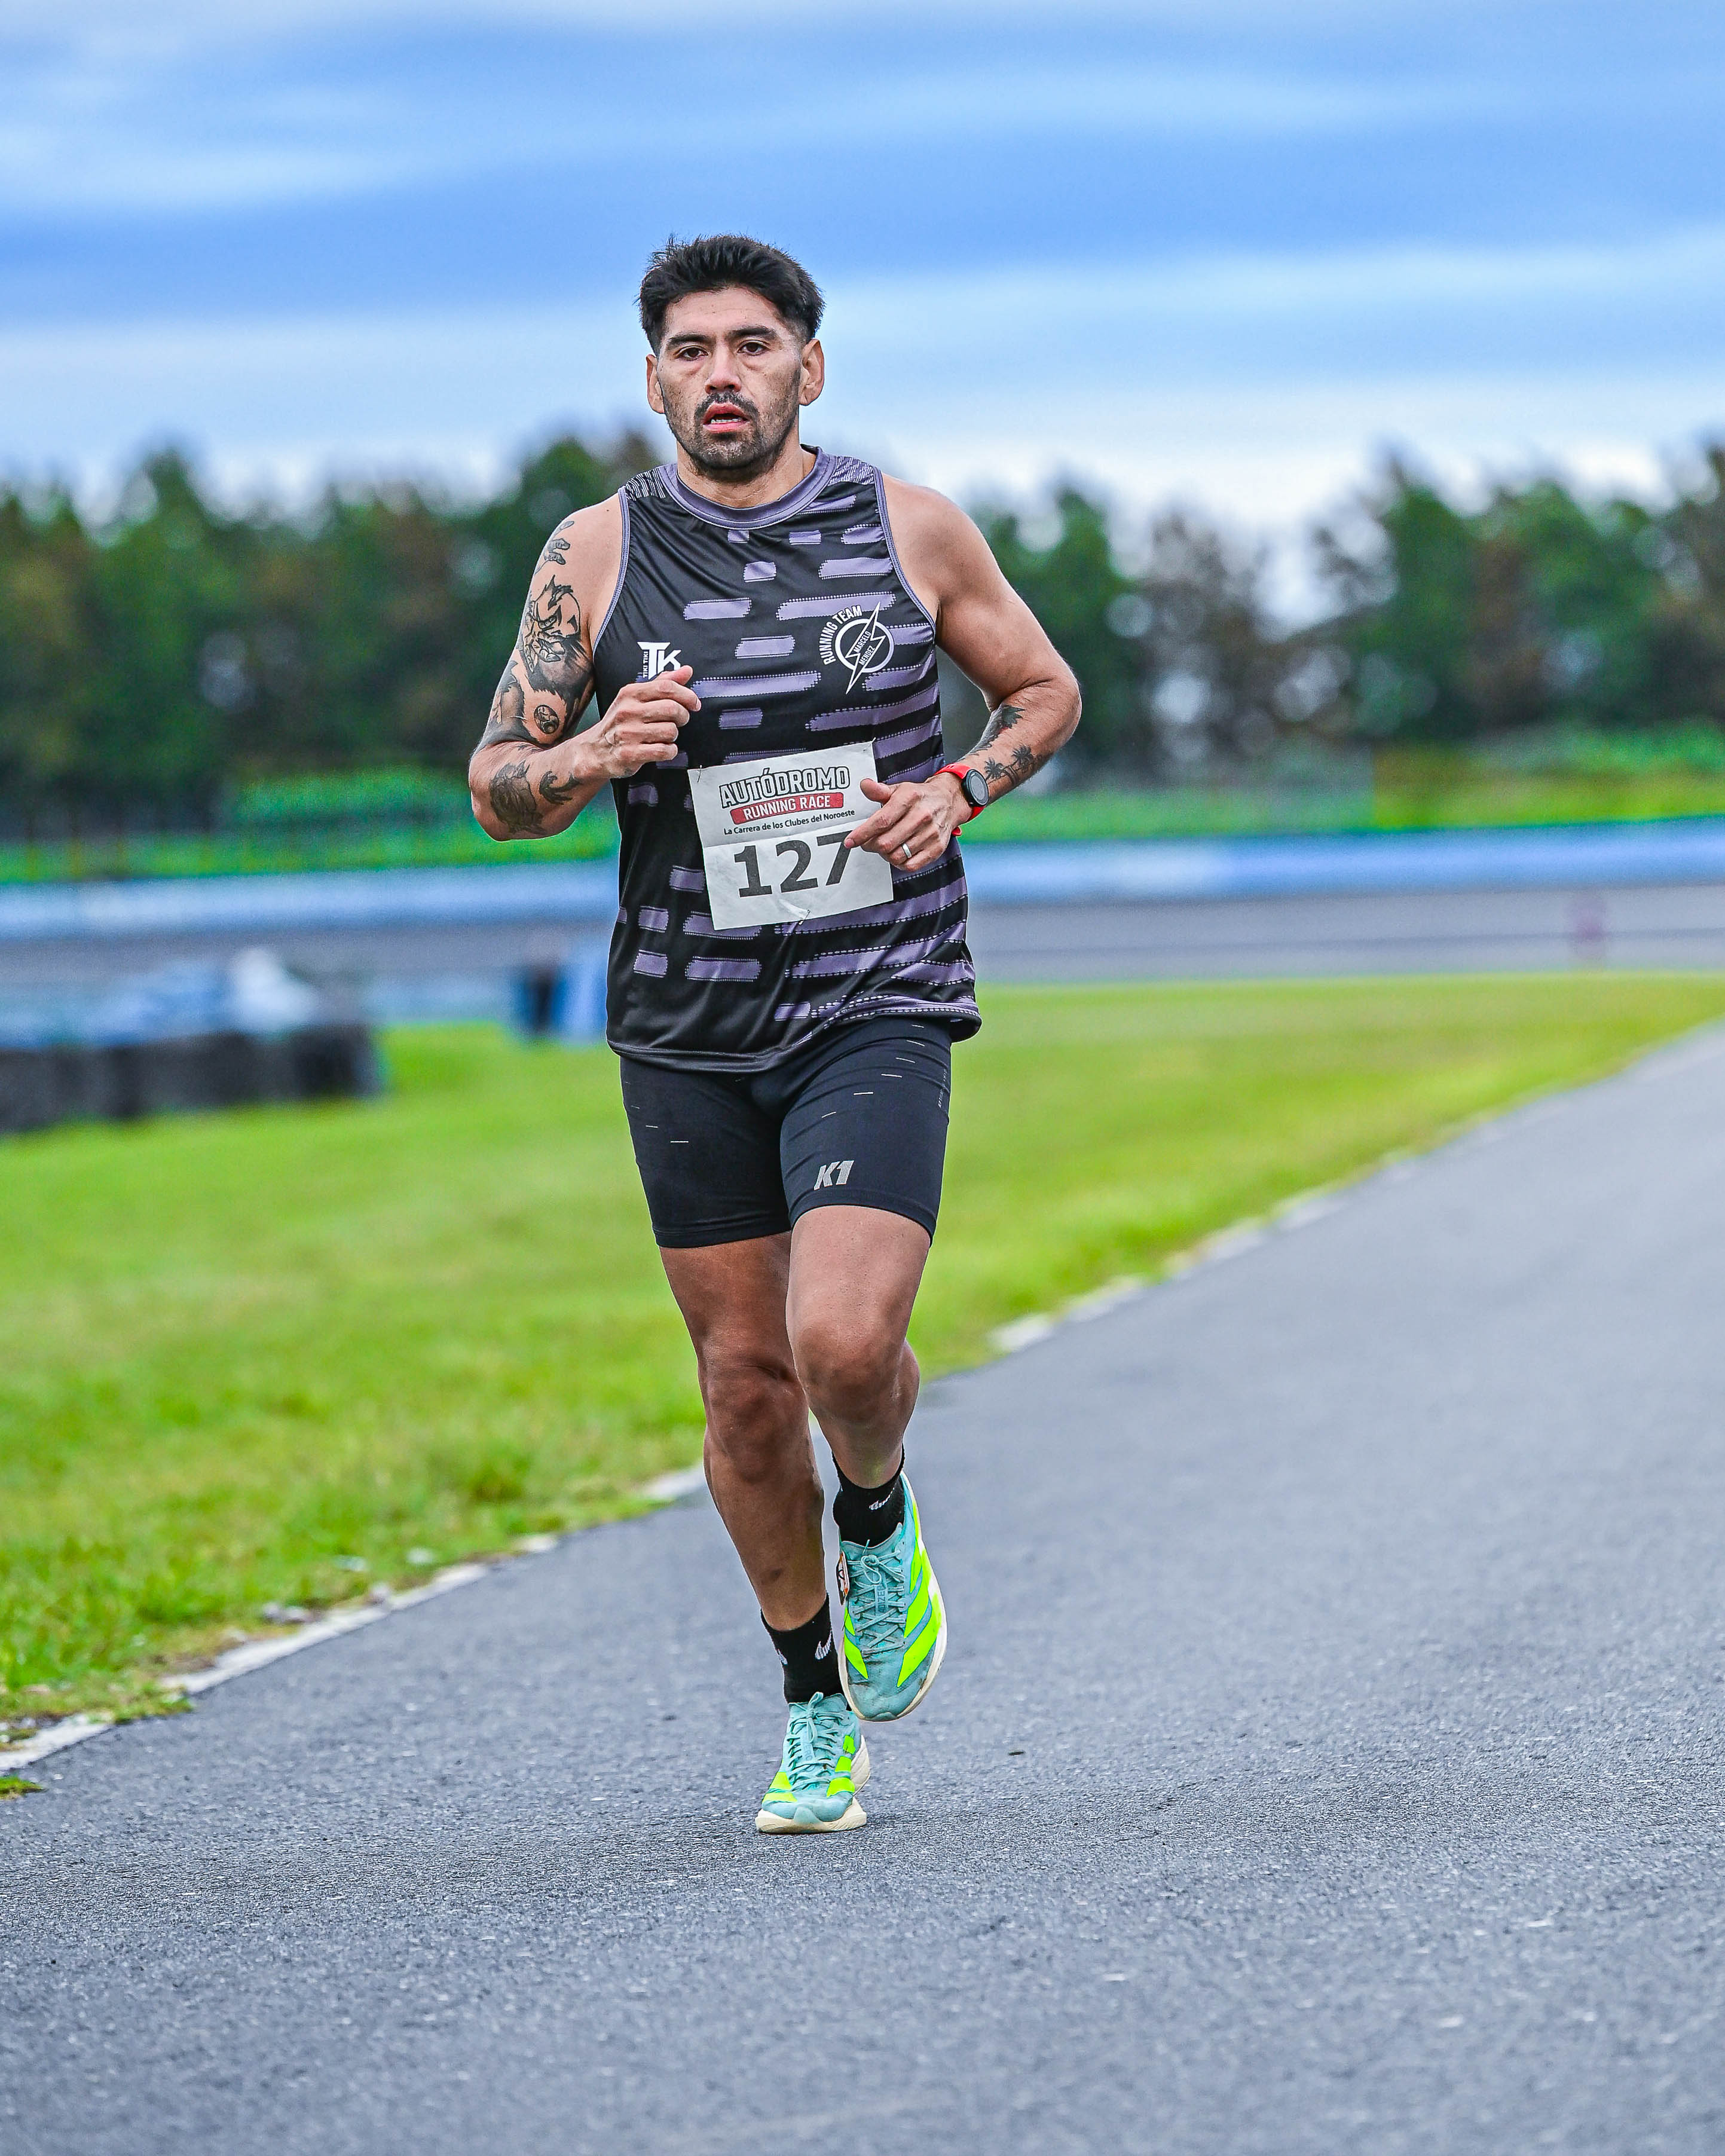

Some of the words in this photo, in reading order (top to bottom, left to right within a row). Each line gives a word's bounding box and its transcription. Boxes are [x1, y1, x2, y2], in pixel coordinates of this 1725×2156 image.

[819, 622, 838, 665] RUNNING
[832, 605, 862, 624] TEAM
[853, 631, 871, 653] MARCELO
[637, 641, 681, 680] TK
[858, 645, 875, 665] MENDEZ
[719, 766, 851, 809] AUTÓDROMO
[733, 825, 760, 834] Carrera
[785, 817, 809, 827] Clubes
[810, 815, 822, 823] del
[824, 809, 855, 820] Noroeste
[743, 798, 796, 820] RUNNING
[799, 795, 831, 809] RACE
[734, 830, 853, 898] 127
[813, 1160, 854, 1191] K1
[877, 1584, 886, 1613] ADIZER
